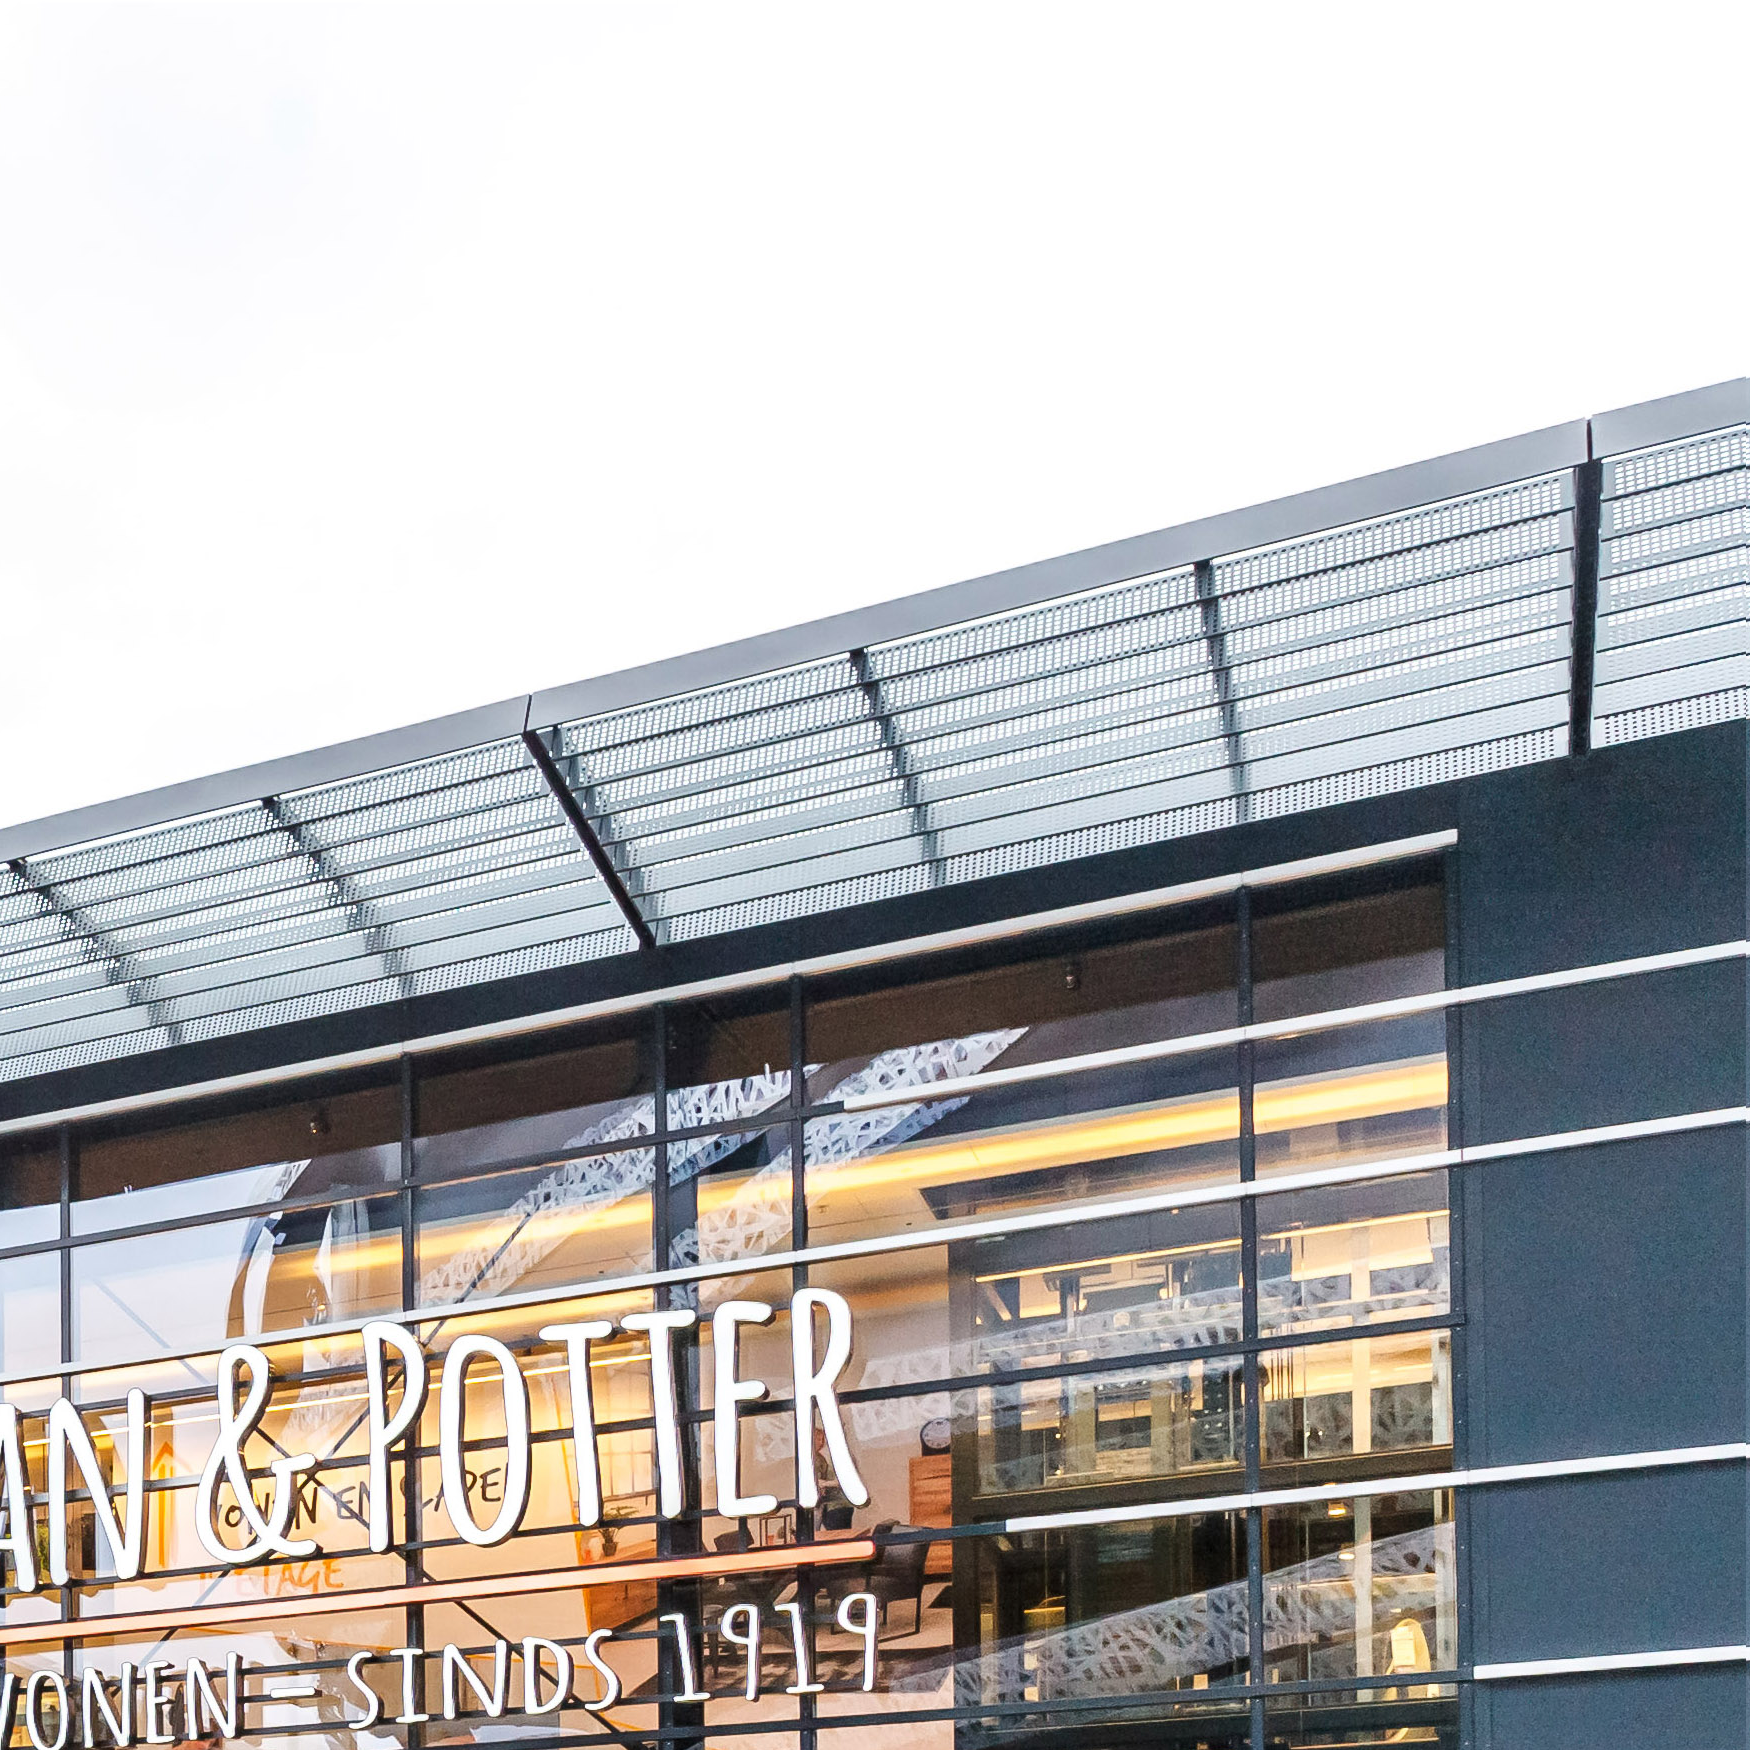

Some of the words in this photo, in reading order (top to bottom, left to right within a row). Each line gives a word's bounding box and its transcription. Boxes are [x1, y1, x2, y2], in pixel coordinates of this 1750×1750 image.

[195, 1344, 319, 1563] &
[360, 1287, 871, 1554] POTTER
[347, 1627, 622, 1731] SINDS
[660, 1592, 880, 1703] 1919
